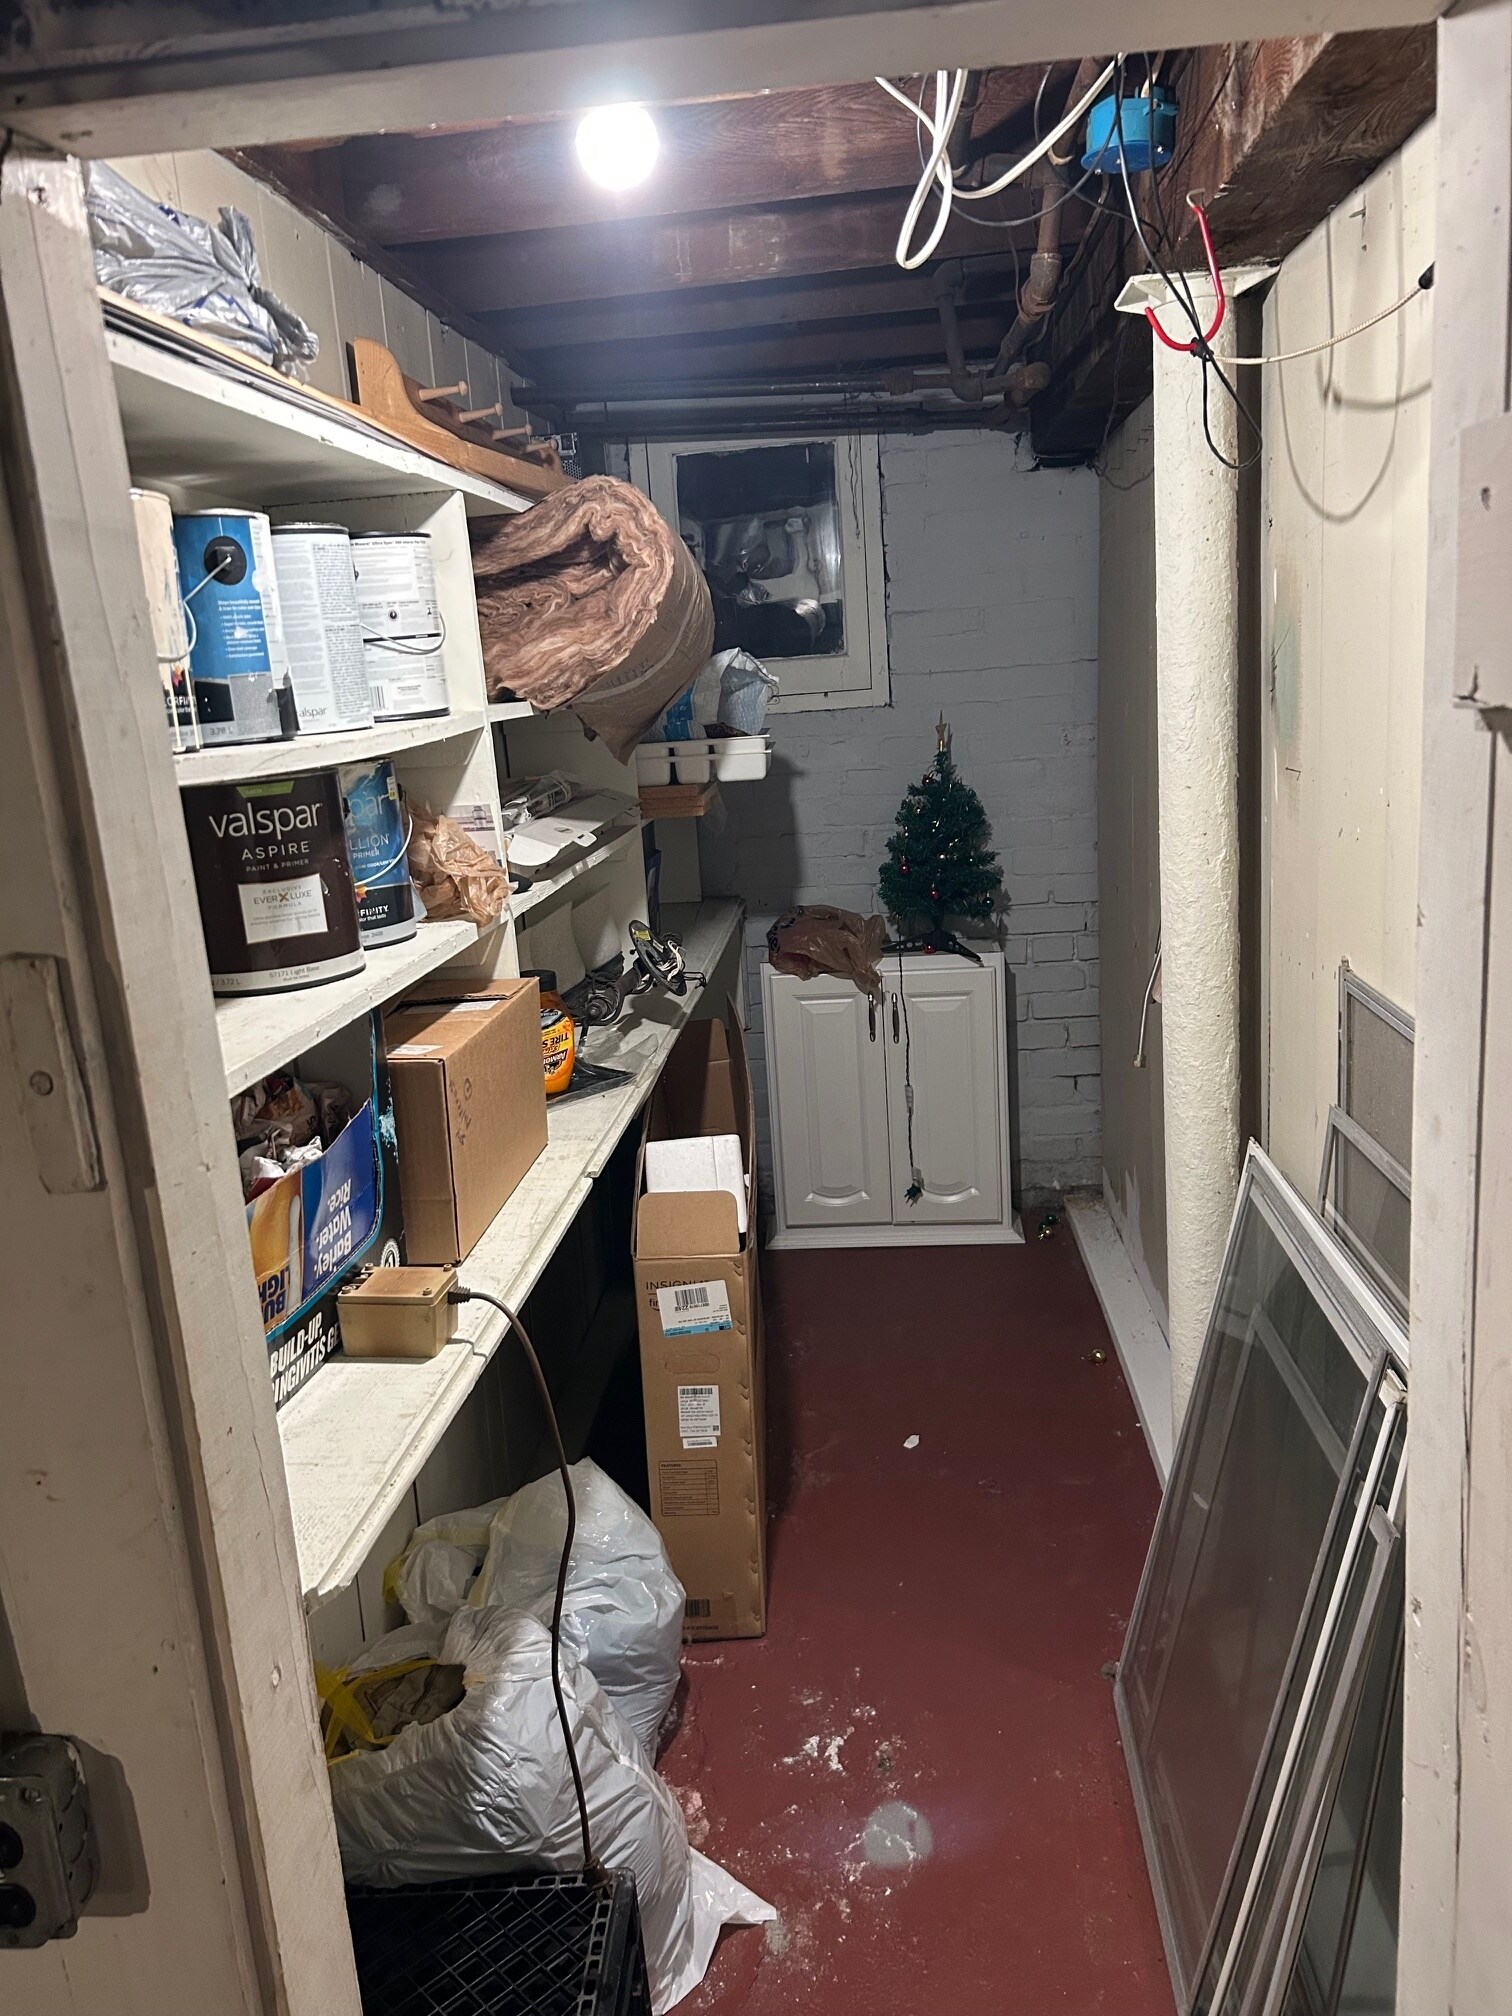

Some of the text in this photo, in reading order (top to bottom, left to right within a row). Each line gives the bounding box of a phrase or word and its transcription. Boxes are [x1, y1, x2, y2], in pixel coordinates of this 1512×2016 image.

[208, 802, 322, 840] valspar
[241, 841, 310, 861] ASPIRE
[353, 849, 380, 860] PRIMER
[246, 858, 310, 872] PAINT & PRIMER
[253, 896, 278, 905] EVER
[290, 890, 312, 900] LUXE
[262, 884, 302, 894] EXCLUSIVE
[268, 902, 302, 910] FORMULA
[358, 904, 389, 917] FINITY
[550, 1032, 569, 1045] TIRE
[327, 1178, 352, 1210] Rice.
[316, 1206, 352, 1250] Water.
[314, 1230, 352, 1280] Barley.
[646, 1280, 706, 1290] INSIGN
[261, 1289, 287, 1324] BU
[270, 1312, 322, 1379] BUILD-UP,
[272, 1336, 327, 1403] INGIVITIS
